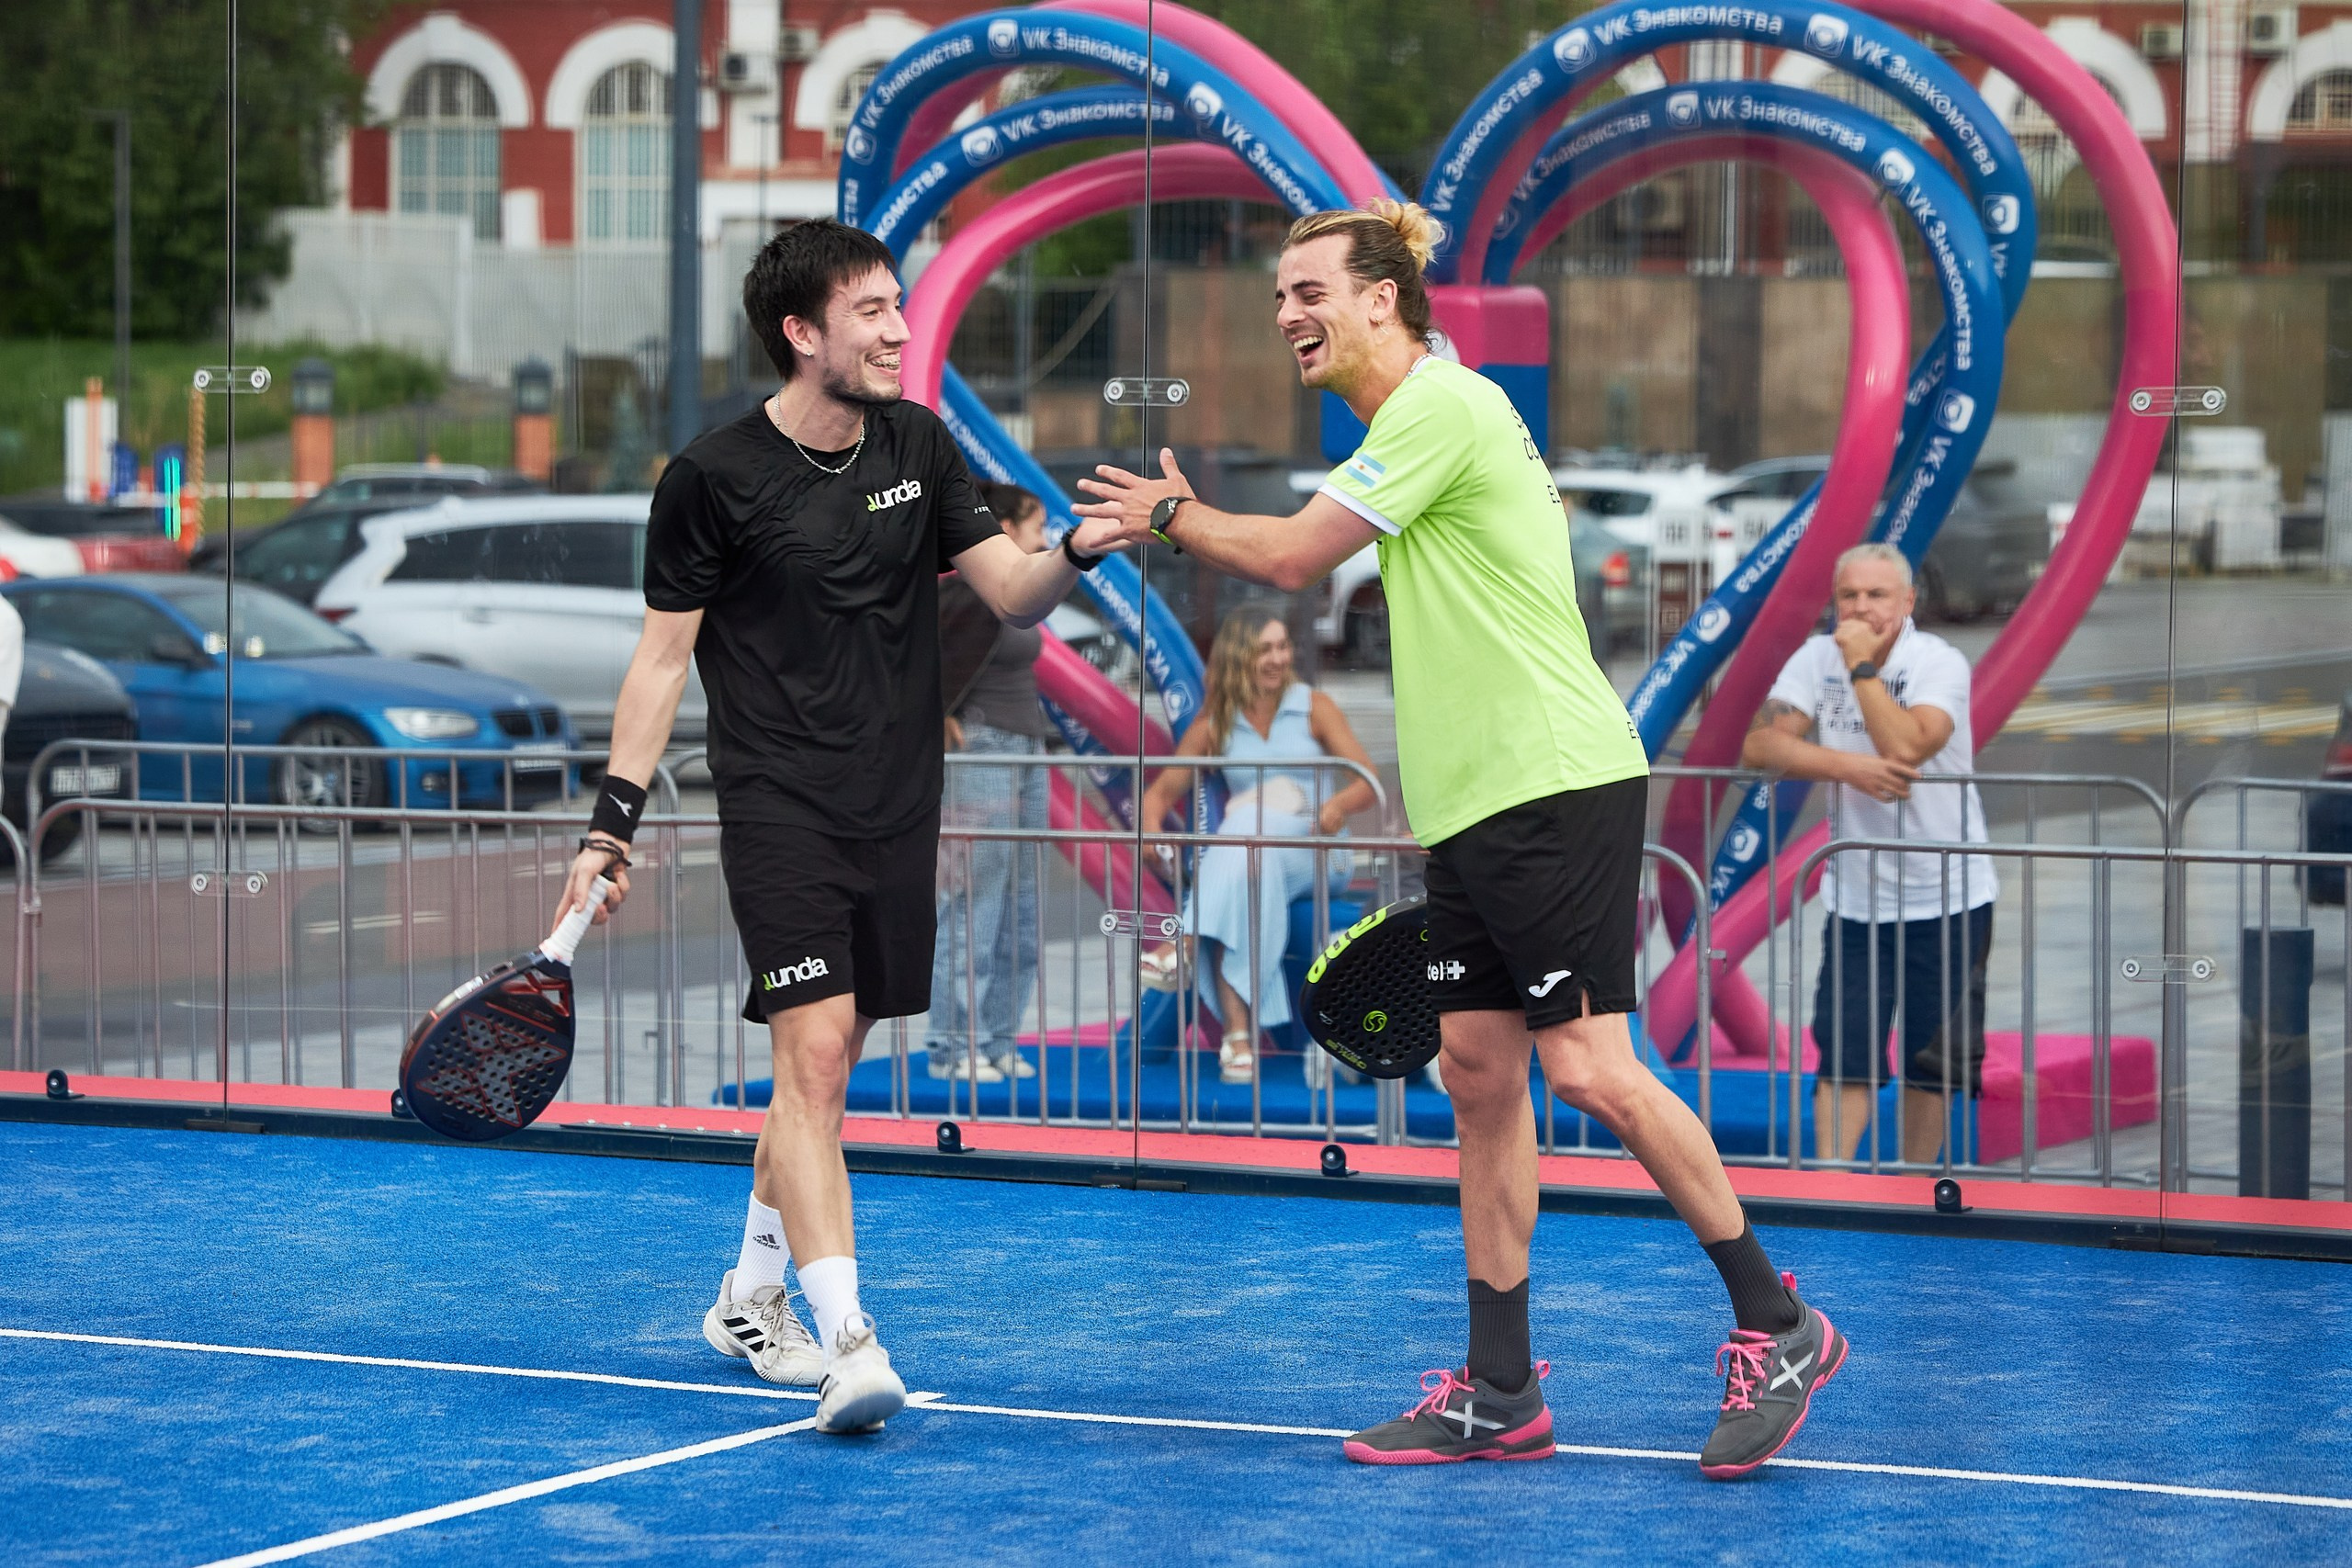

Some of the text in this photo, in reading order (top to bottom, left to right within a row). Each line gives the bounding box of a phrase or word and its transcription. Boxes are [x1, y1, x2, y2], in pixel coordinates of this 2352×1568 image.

[1022, 26, 1053, 51] VK
[1593, 6, 1784, 46] VK Знакомства
[861, 35, 975, 130] VK Знакомства
[1851, 34, 1998, 177] VK Знакомства
[1001, 114, 1040, 142] VK
[1429, 67, 1544, 213] VK Знакомства
[1703, 95, 1867, 153] VK Знакомства
[872, 161, 950, 243] комства
[1222, 114, 1319, 217] VK Знаком
[1511, 168, 1542, 202] VK
[1905, 185, 1973, 372] VK Знакомства
